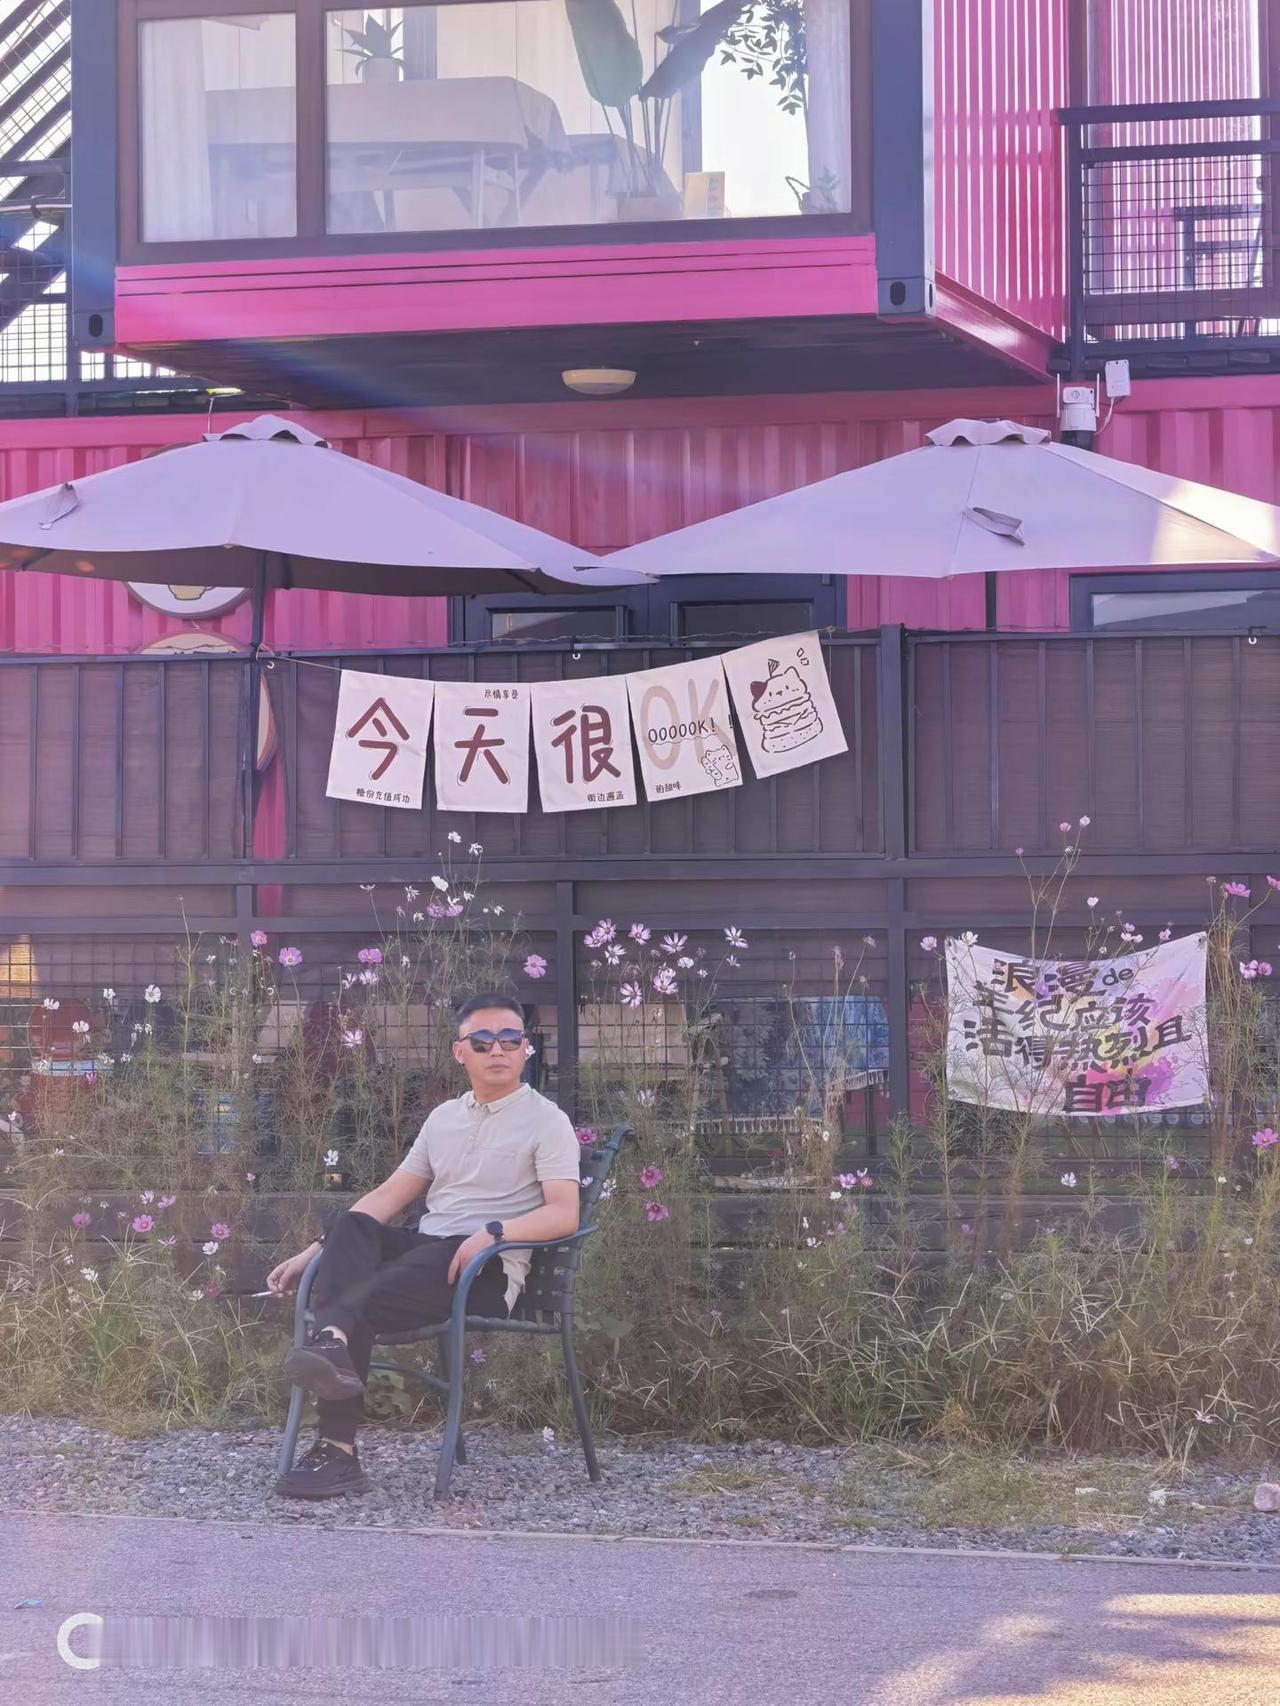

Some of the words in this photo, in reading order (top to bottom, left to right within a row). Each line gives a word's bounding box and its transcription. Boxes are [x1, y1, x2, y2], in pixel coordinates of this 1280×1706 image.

[347, 697, 410, 780] 今
[454, 707, 512, 785] 天
[551, 705, 621, 784] 很
[641, 679, 737, 769] OK
[1063, 1068, 1152, 1112] 自由
